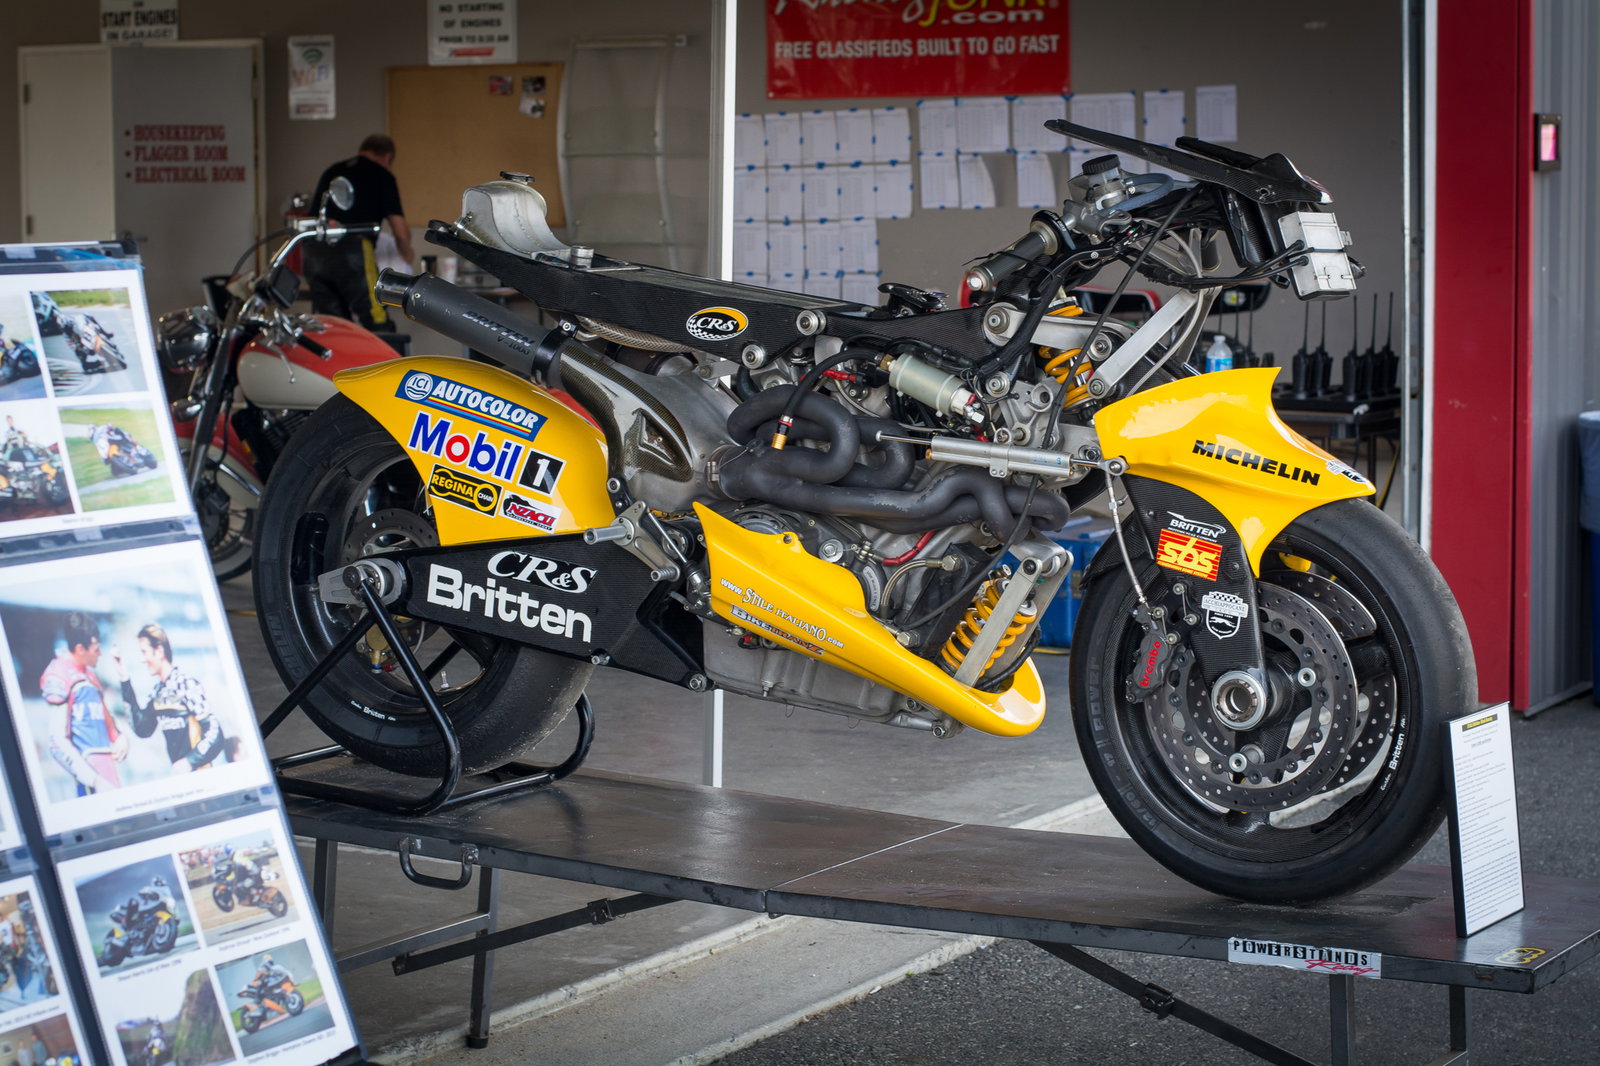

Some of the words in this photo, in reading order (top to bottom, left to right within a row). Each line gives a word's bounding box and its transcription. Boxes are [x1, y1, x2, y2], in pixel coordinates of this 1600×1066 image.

[102, 11, 132, 28] START
[135, 8, 177, 27] ENGINES
[439, 5, 453, 13] NO
[457, 3, 504, 12] STARTING
[443, 19, 456, 28] OF
[461, 18, 502, 27] ENGINES
[106, 31, 119, 40] IN
[775, 41, 812, 59] FREE
[816, 39, 913, 59] CLASSIFIEDS
[917, 38, 962, 57] BUILT
[967, 37, 988, 56] TO
[993, 36, 1016, 55] GO
[1020, 35, 1060, 54] FAST
[134, 125, 226, 141] HOUSEKEEPING
[135, 145, 189, 162] FLAGGER
[194, 145, 228, 162] ROOM
[135, 167, 209, 184] ELECTRICAL
[211, 166, 246, 182] ROOM
[462, 311, 535, 347] BRITTEN
[411, 376, 428, 389] ICI
[432, 381, 539, 429] AUTOCOLOR
[408, 411, 524, 481] Mobil
[532, 458, 550, 487] 1
[1192, 440, 1320, 486] MICHELIN
[431, 474, 474, 498] REGINA
[477, 491, 494, 503] CHAIN
[506, 504, 557, 527] NZACU
[1170, 519, 1220, 539] BRITTEN
[487, 551, 598, 594] CR&S
[427, 563, 592, 643] Britten
[1139, 641, 1162, 687] brembo
[363, 706, 386, 720] Britten
[1389, 733, 1405, 770] Britten
[1233, 940, 1368, 966] POWERSTANDS
[1304, 960, 1380, 975] Racing
